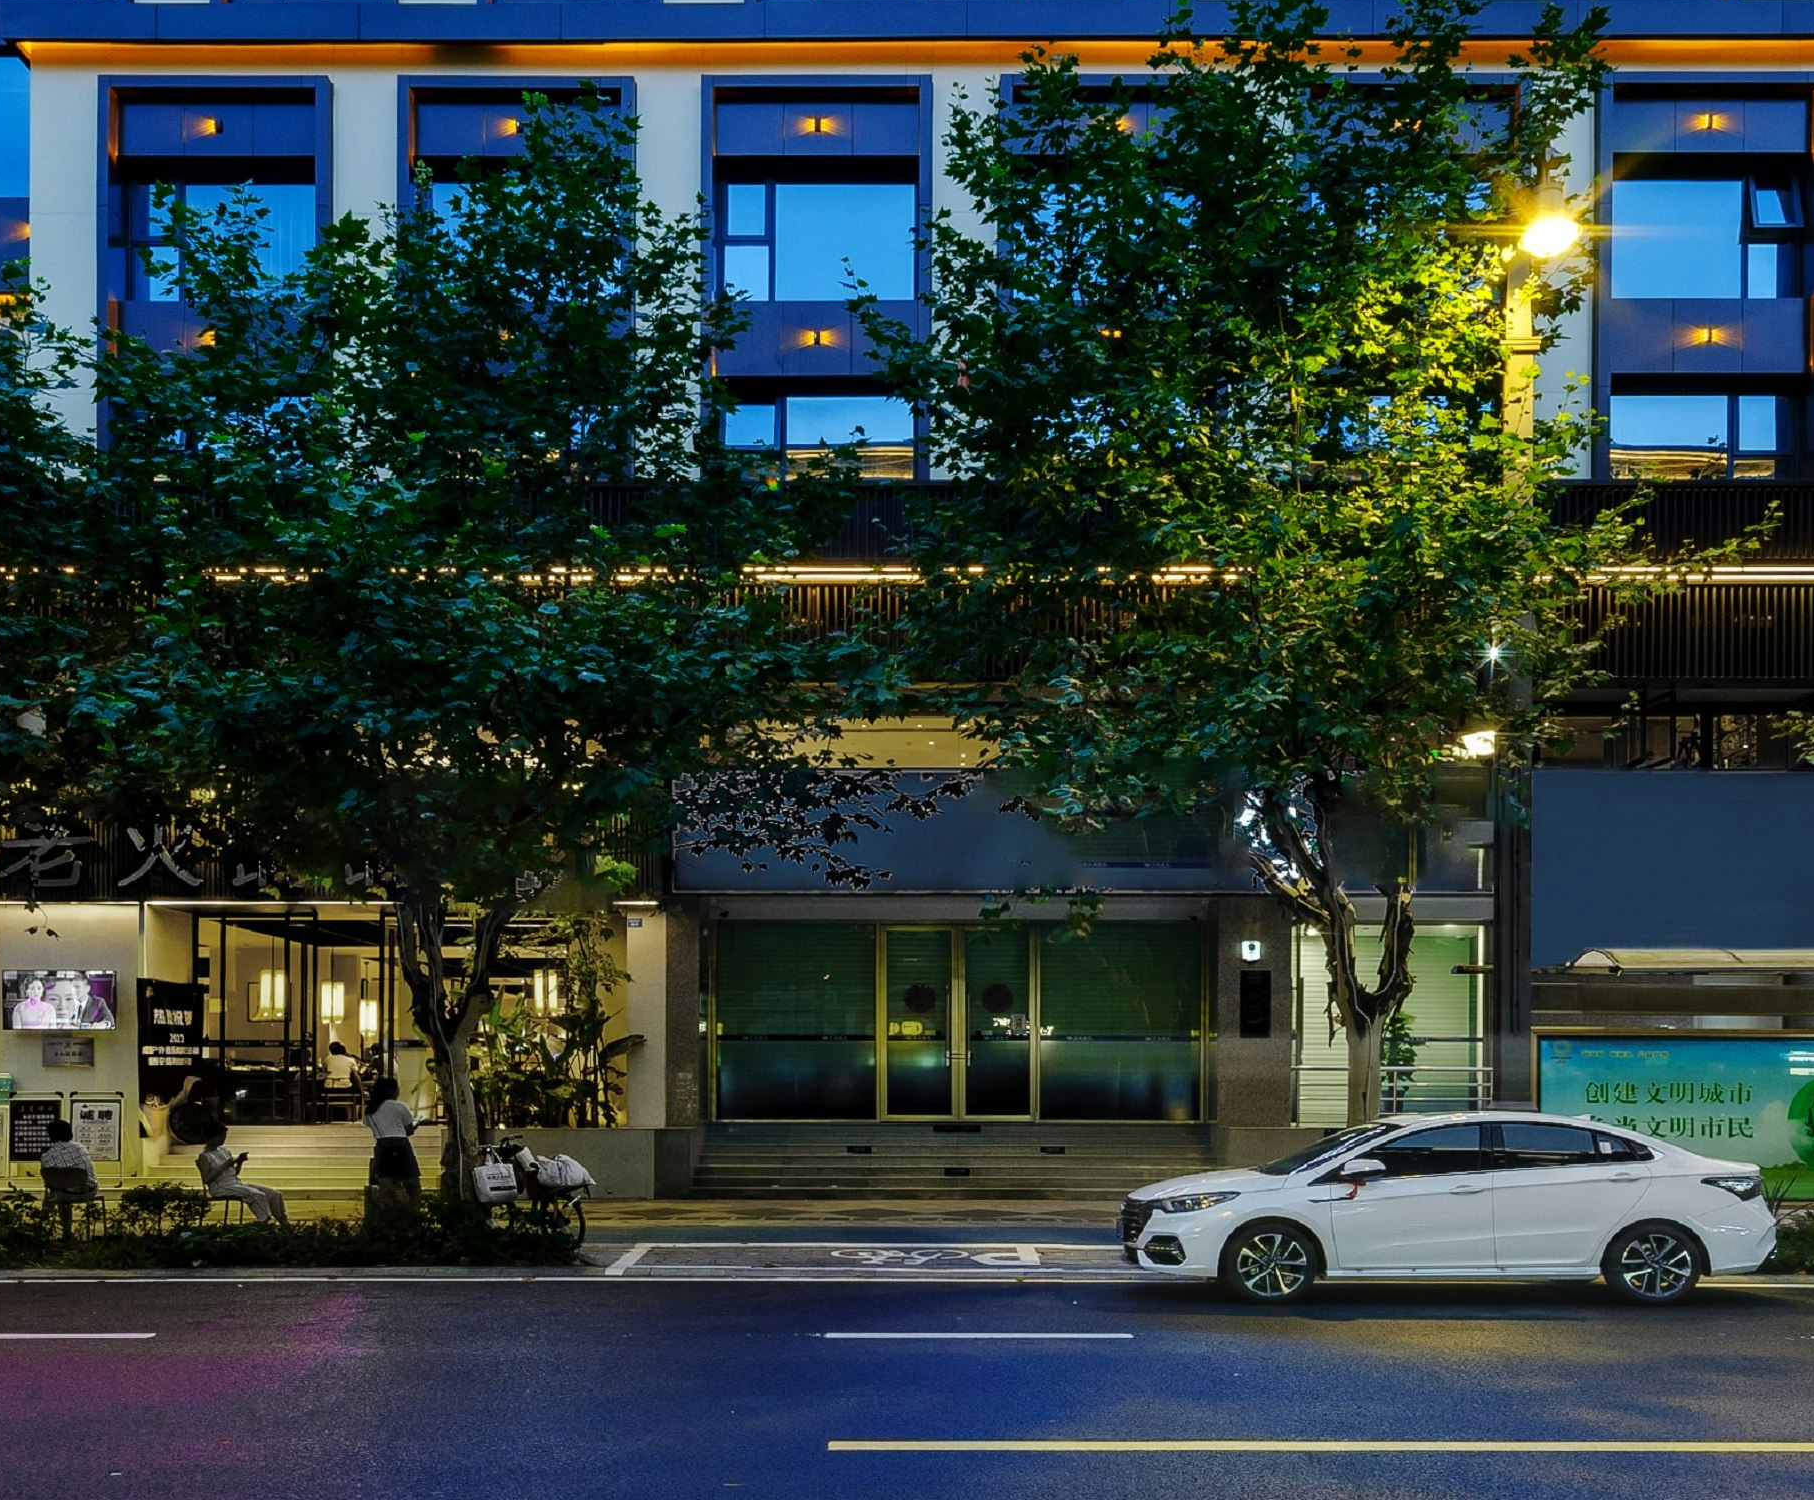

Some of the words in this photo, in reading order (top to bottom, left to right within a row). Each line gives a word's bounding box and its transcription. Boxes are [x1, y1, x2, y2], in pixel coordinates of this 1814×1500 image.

[1585, 1081, 1753, 1105] 创建文明城市
